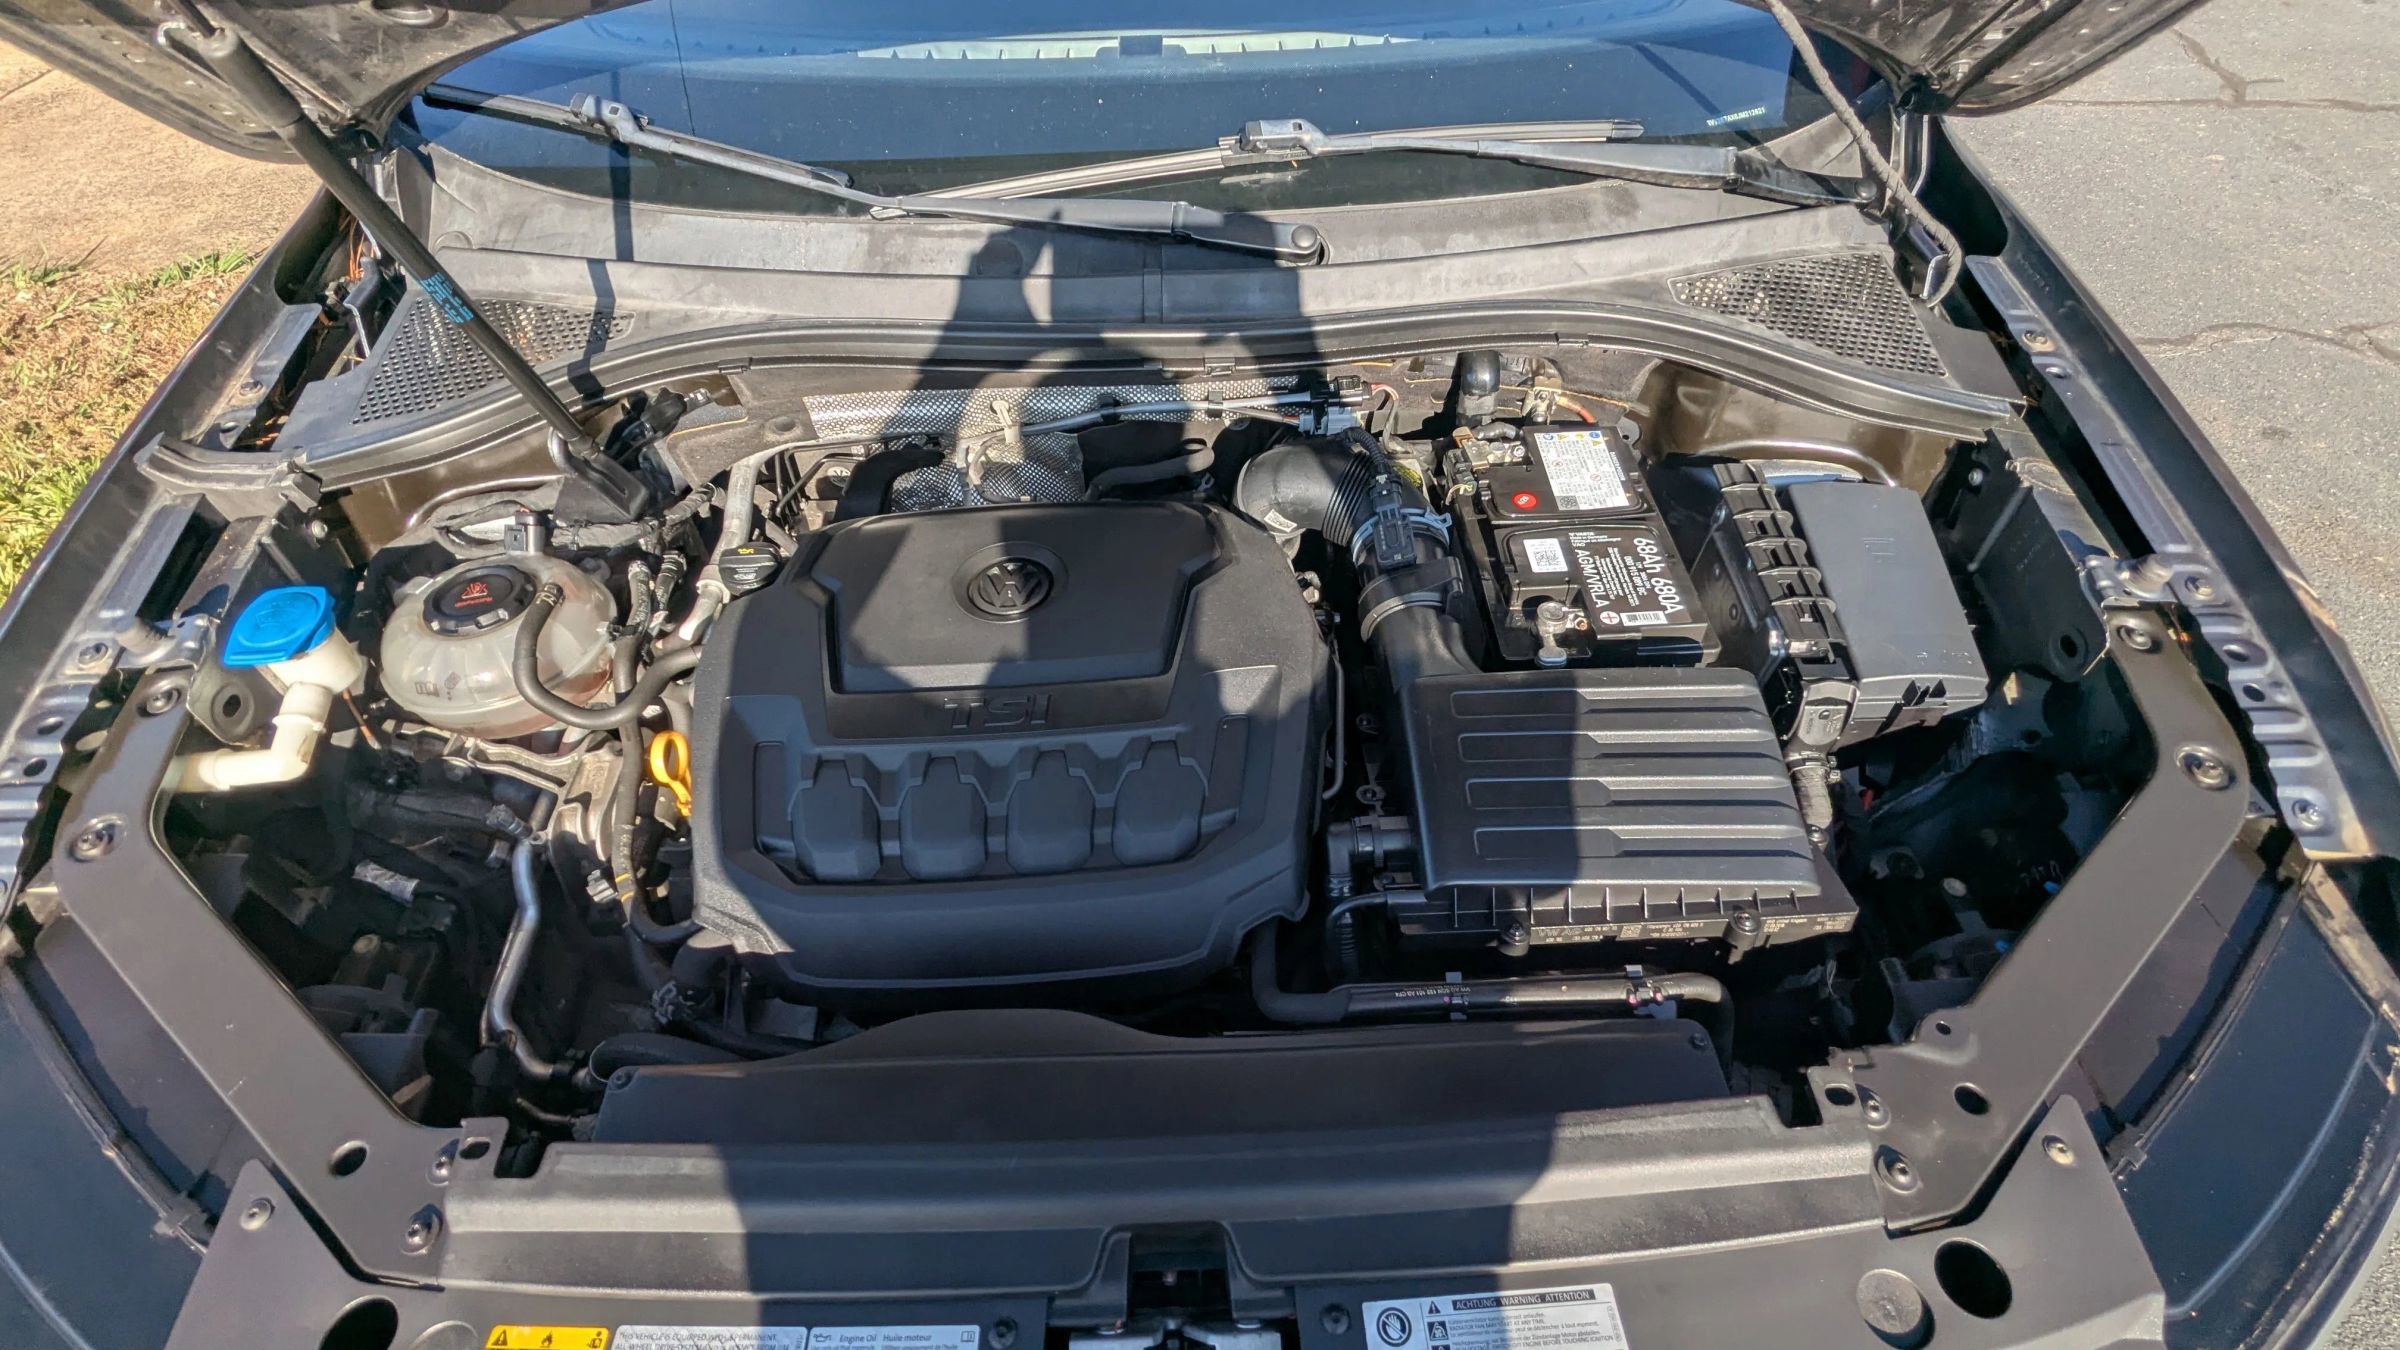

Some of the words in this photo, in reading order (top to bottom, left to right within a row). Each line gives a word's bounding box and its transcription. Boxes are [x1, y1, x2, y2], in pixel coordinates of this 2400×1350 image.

[1575, 549, 1610, 608] AGM/VRLA
[1633, 537, 1665, 573] 68Ah
[1651, 577, 1685, 614] 680A
[944, 694, 1053, 729] TSI
[1456, 1299, 1497, 1310] ACHTUNG
[1501, 1295, 1542, 1306] WARNING
[1545, 1292, 1590, 1303] ATTENTION
[840, 1334, 864, 1344] Engine
[866, 1334, 878, 1342] Oil
[883, 1334, 902, 1342] Huile
